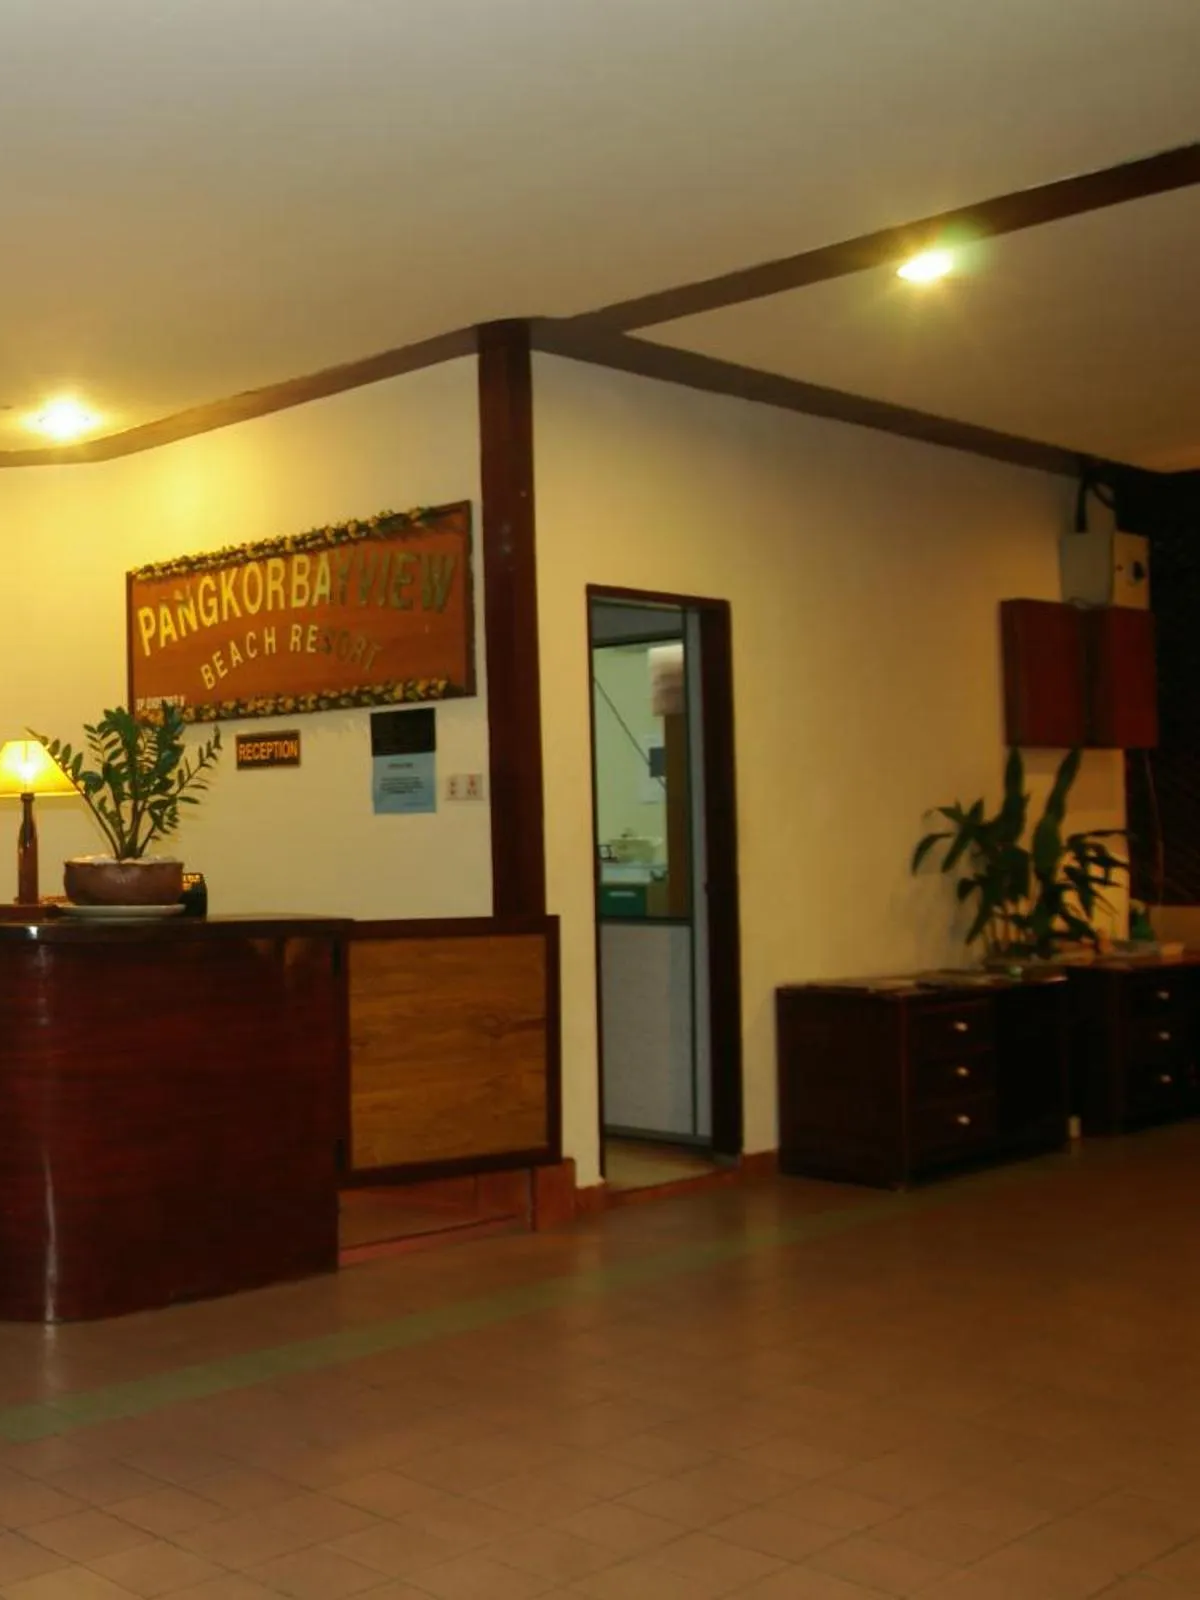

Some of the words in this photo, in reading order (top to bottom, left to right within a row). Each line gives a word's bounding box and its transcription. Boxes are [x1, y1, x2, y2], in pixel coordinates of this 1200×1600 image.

[200, 625, 277, 690] BEACH
[289, 624, 383, 672] RESORT
[239, 740, 298, 761] RECEPTION
